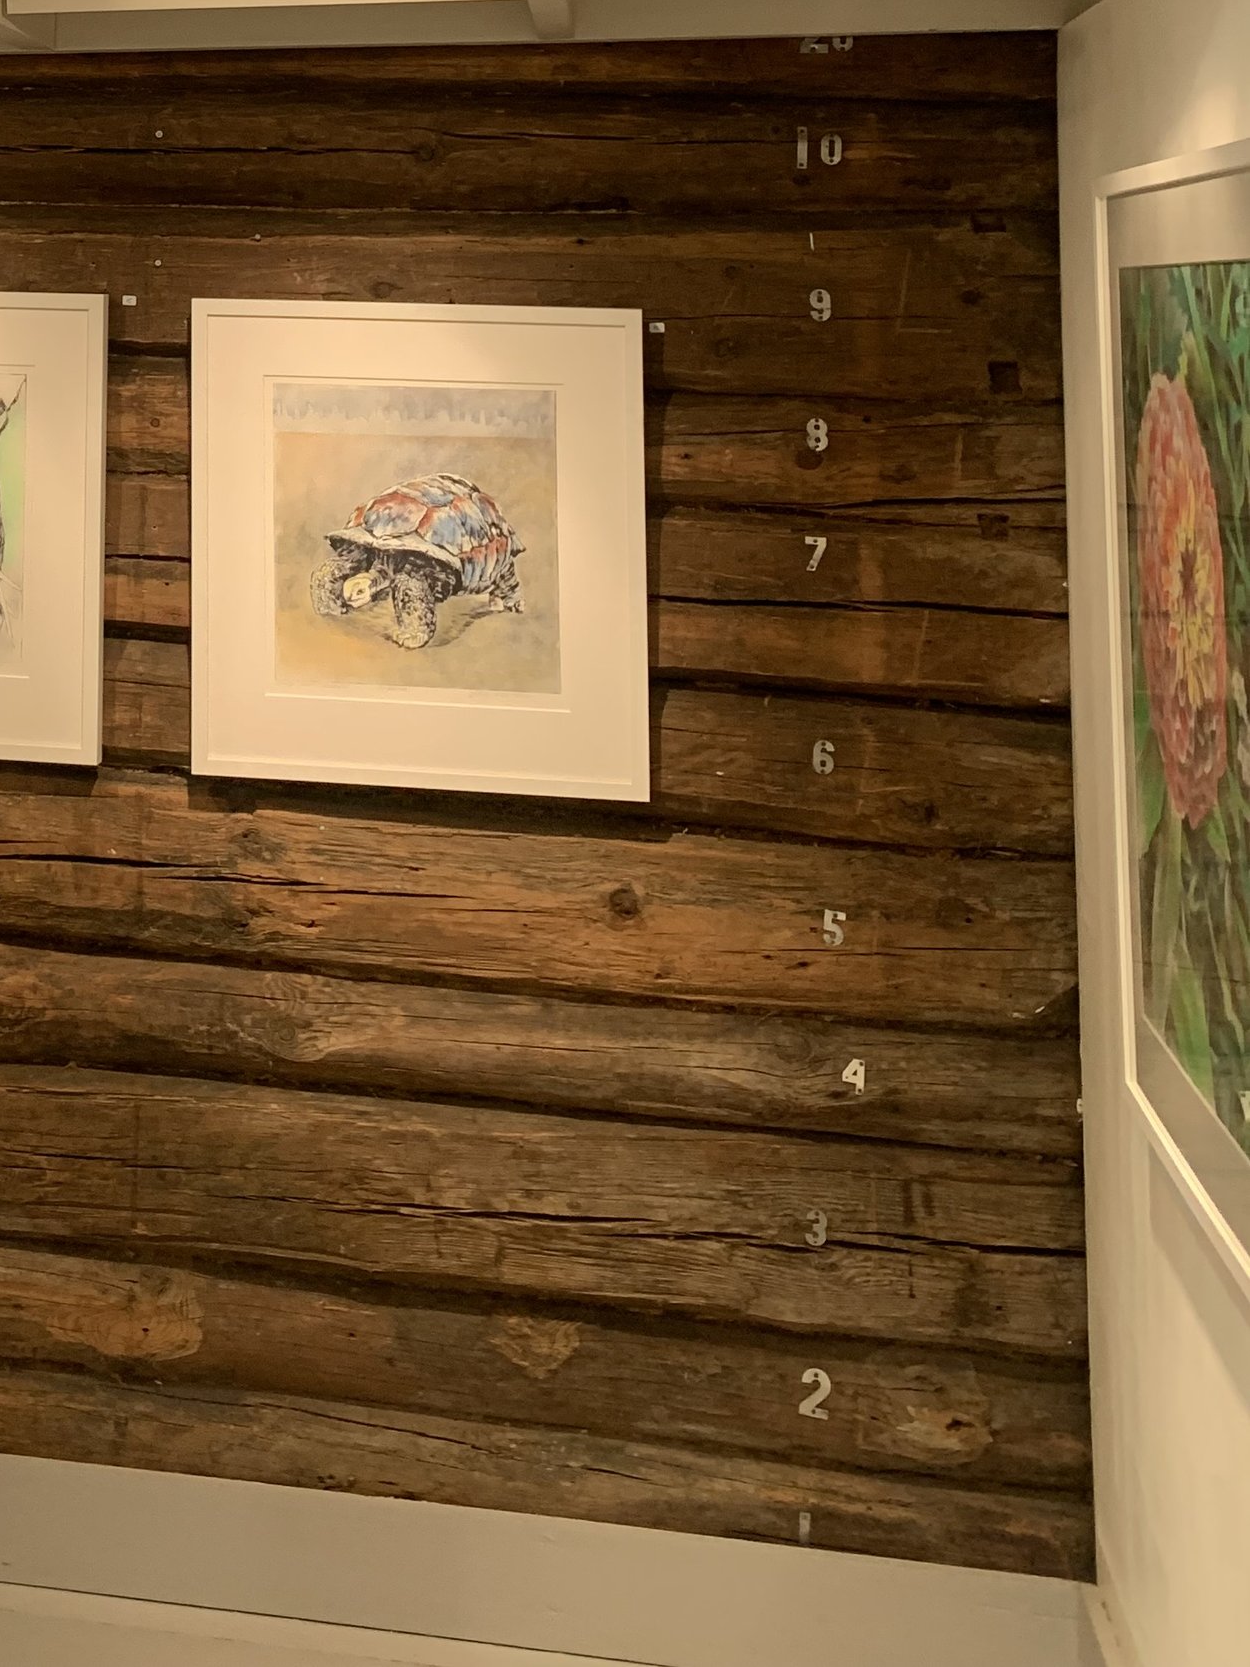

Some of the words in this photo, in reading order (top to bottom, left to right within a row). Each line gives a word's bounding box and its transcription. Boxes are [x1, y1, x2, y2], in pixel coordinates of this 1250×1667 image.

[797, 126, 843, 169] 10
[809, 289, 832, 322] 9
[806, 417, 829, 452] 8
[804, 536, 827, 572] 7
[812, 739, 836, 775] 6
[822, 909, 847, 946] 5
[841, 1058, 866, 1096] 4
[804, 1209, 828, 1247] 3
[797, 1367, 832, 1420] 2
